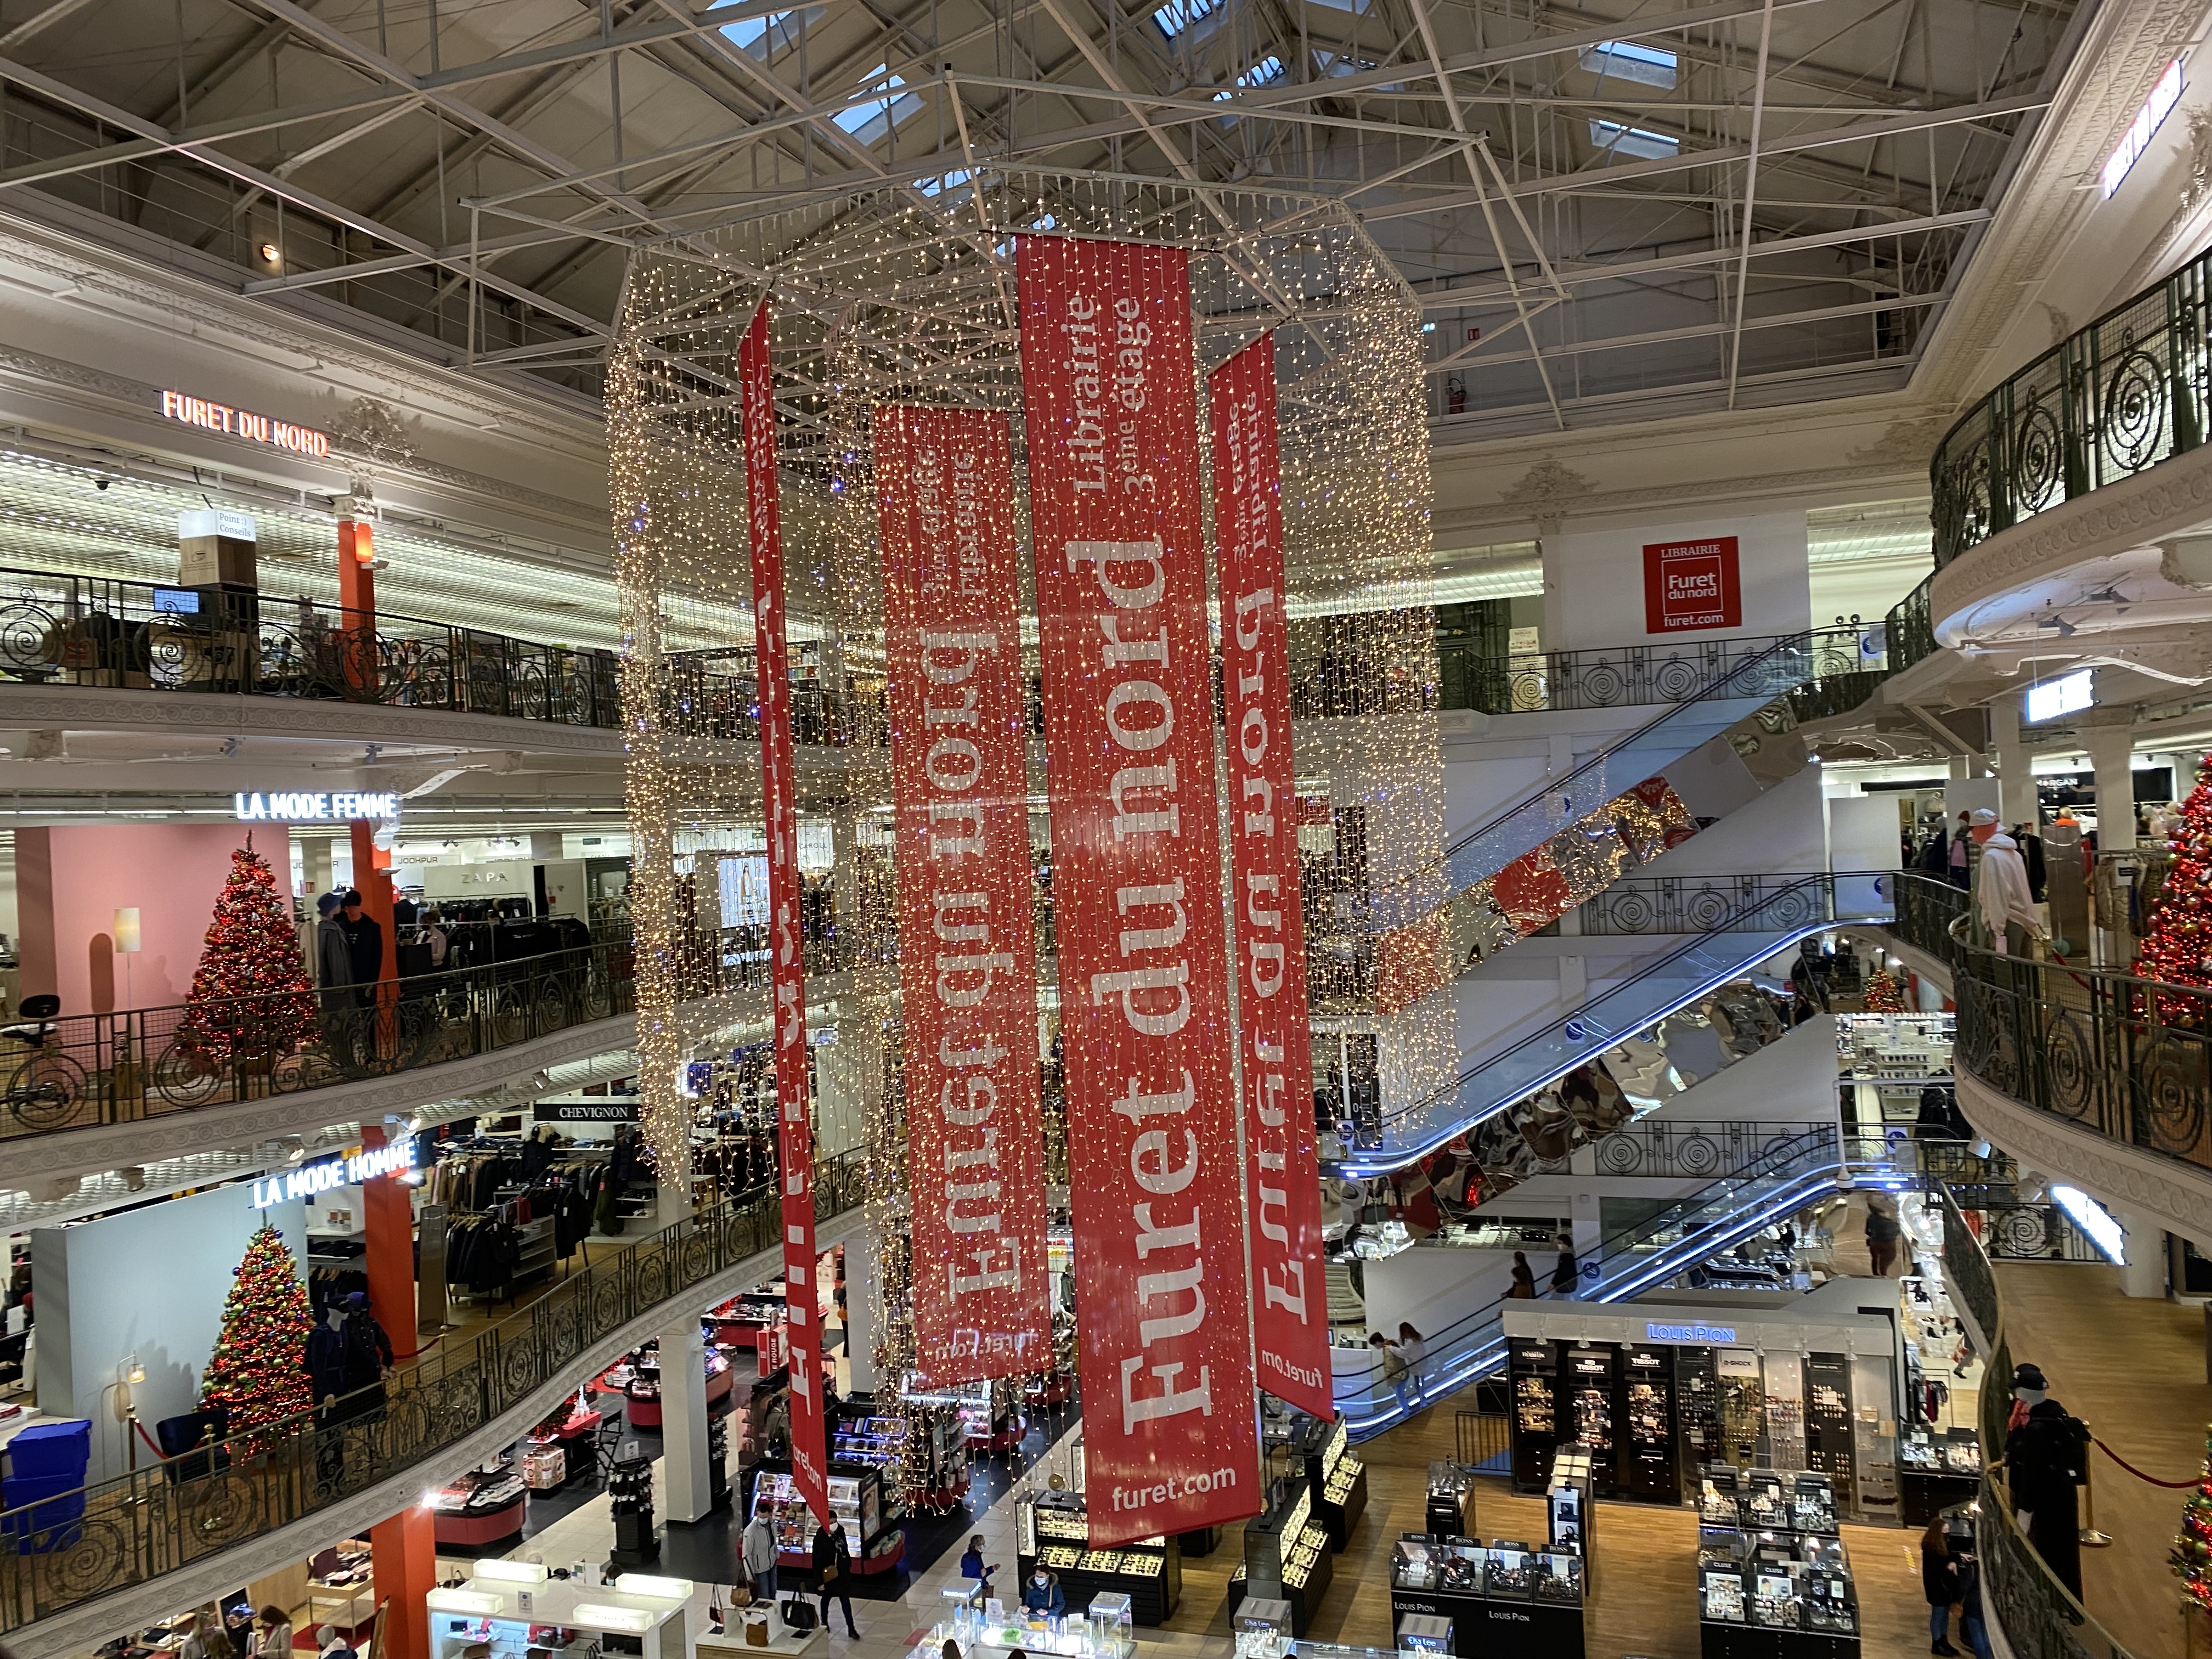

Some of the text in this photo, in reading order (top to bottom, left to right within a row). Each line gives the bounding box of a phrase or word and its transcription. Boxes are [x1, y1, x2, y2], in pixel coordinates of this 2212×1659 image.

[1061, 296, 1106, 493] Librairie
[1111, 298, 1154, 495] 3ème étage
[162, 390, 329, 457] FURET DU NORD
[219, 512, 240, 524] Point
[219, 524, 251, 537] Conseils
[1661, 544, 1721, 558] LIBRAIRIE
[1668, 572, 1716, 589] Furet
[1668, 585, 1718, 600] du nord
[1663, 613, 1724, 627] furet.com
[236, 793, 397, 820] LA MODE FEMME
[460, 872, 509, 884] ZAPA
[1064, 533, 1214, 1436] Furet du nord
[558, 1106, 629, 1119] CHEVIGNON
[253, 1142, 416, 1209] LA MODE HOMME
[1649, 1325, 1735, 1342] LOUIS PION
[1111, 1465, 1236, 1513] furet.com
[1455, 1537, 1474, 1545] BOSS
[1394, 1601, 1436, 1612] LOUIS PION
[1488, 1611, 1530, 1622] LOUIS PION
